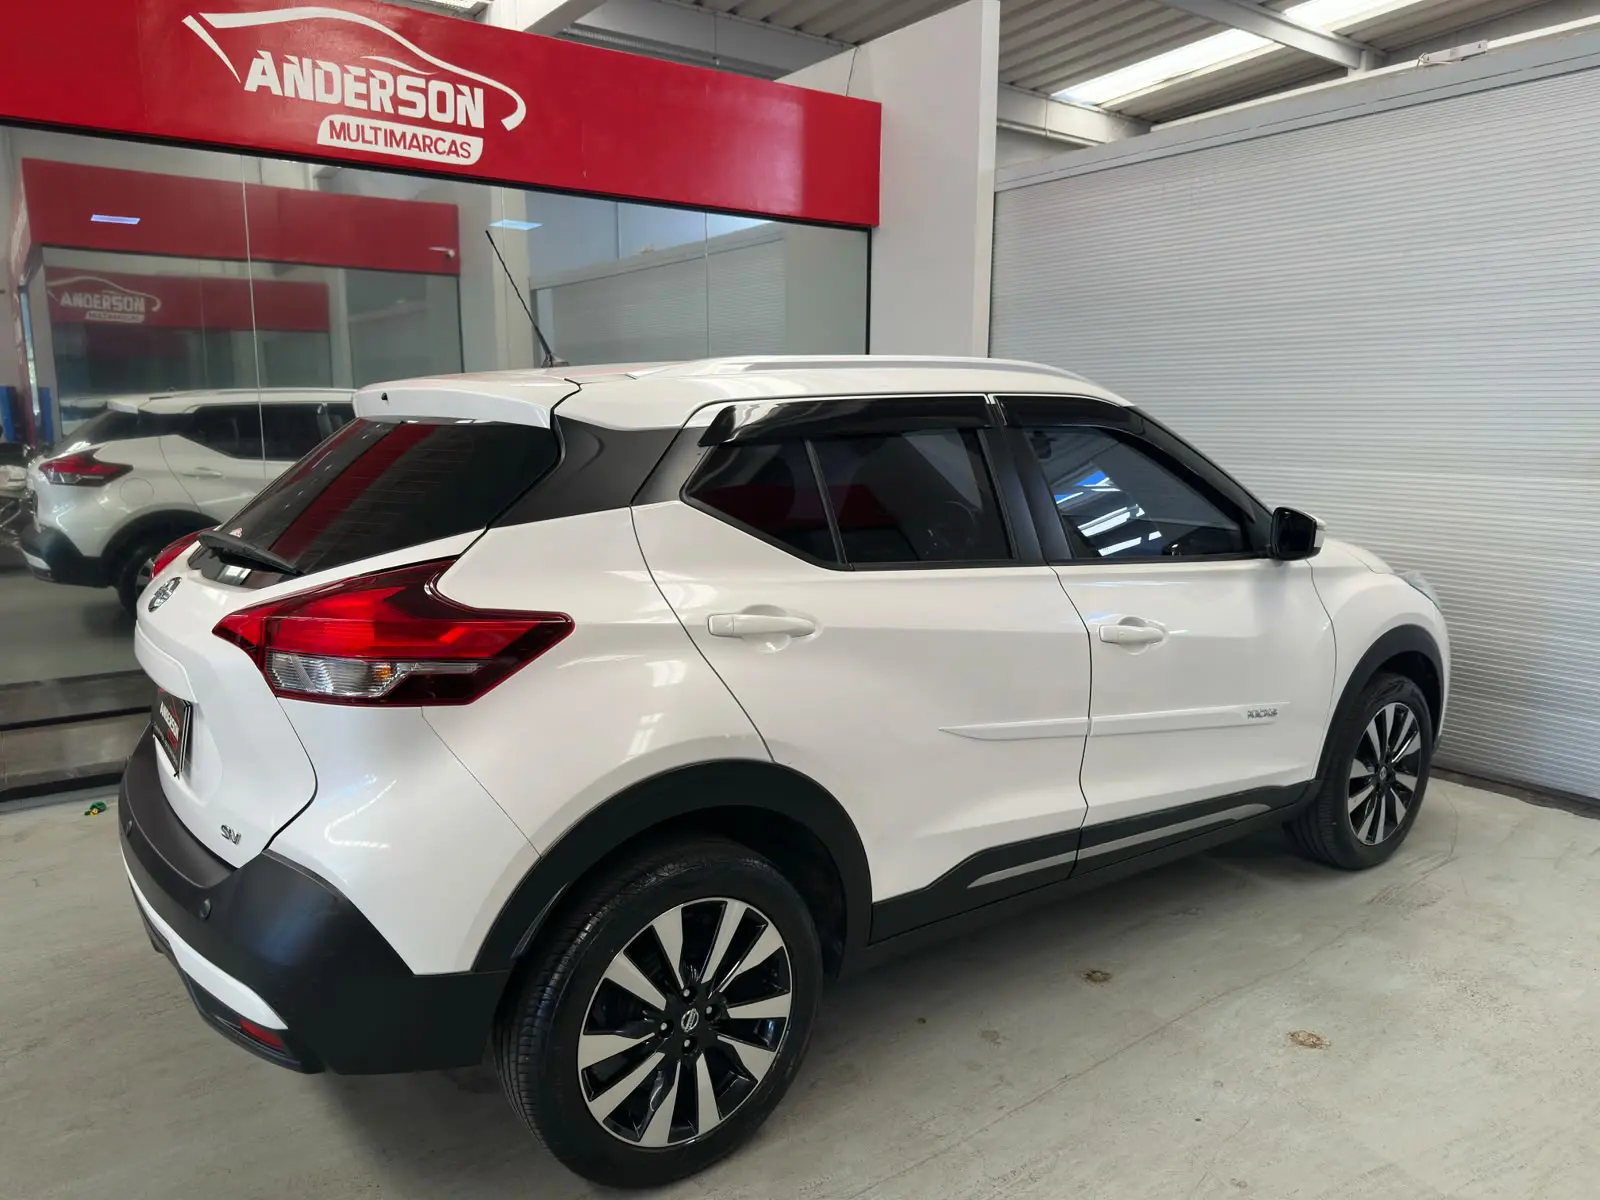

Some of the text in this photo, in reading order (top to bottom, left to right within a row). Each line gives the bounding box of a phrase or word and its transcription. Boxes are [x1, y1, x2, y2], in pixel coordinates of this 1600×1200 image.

[244, 49, 484, 129] ANDERSON
[328, 119, 472, 159] MULTIMARCAS
[60, 291, 145, 313] ANDERSON
[220, 824, 242, 845] SV
